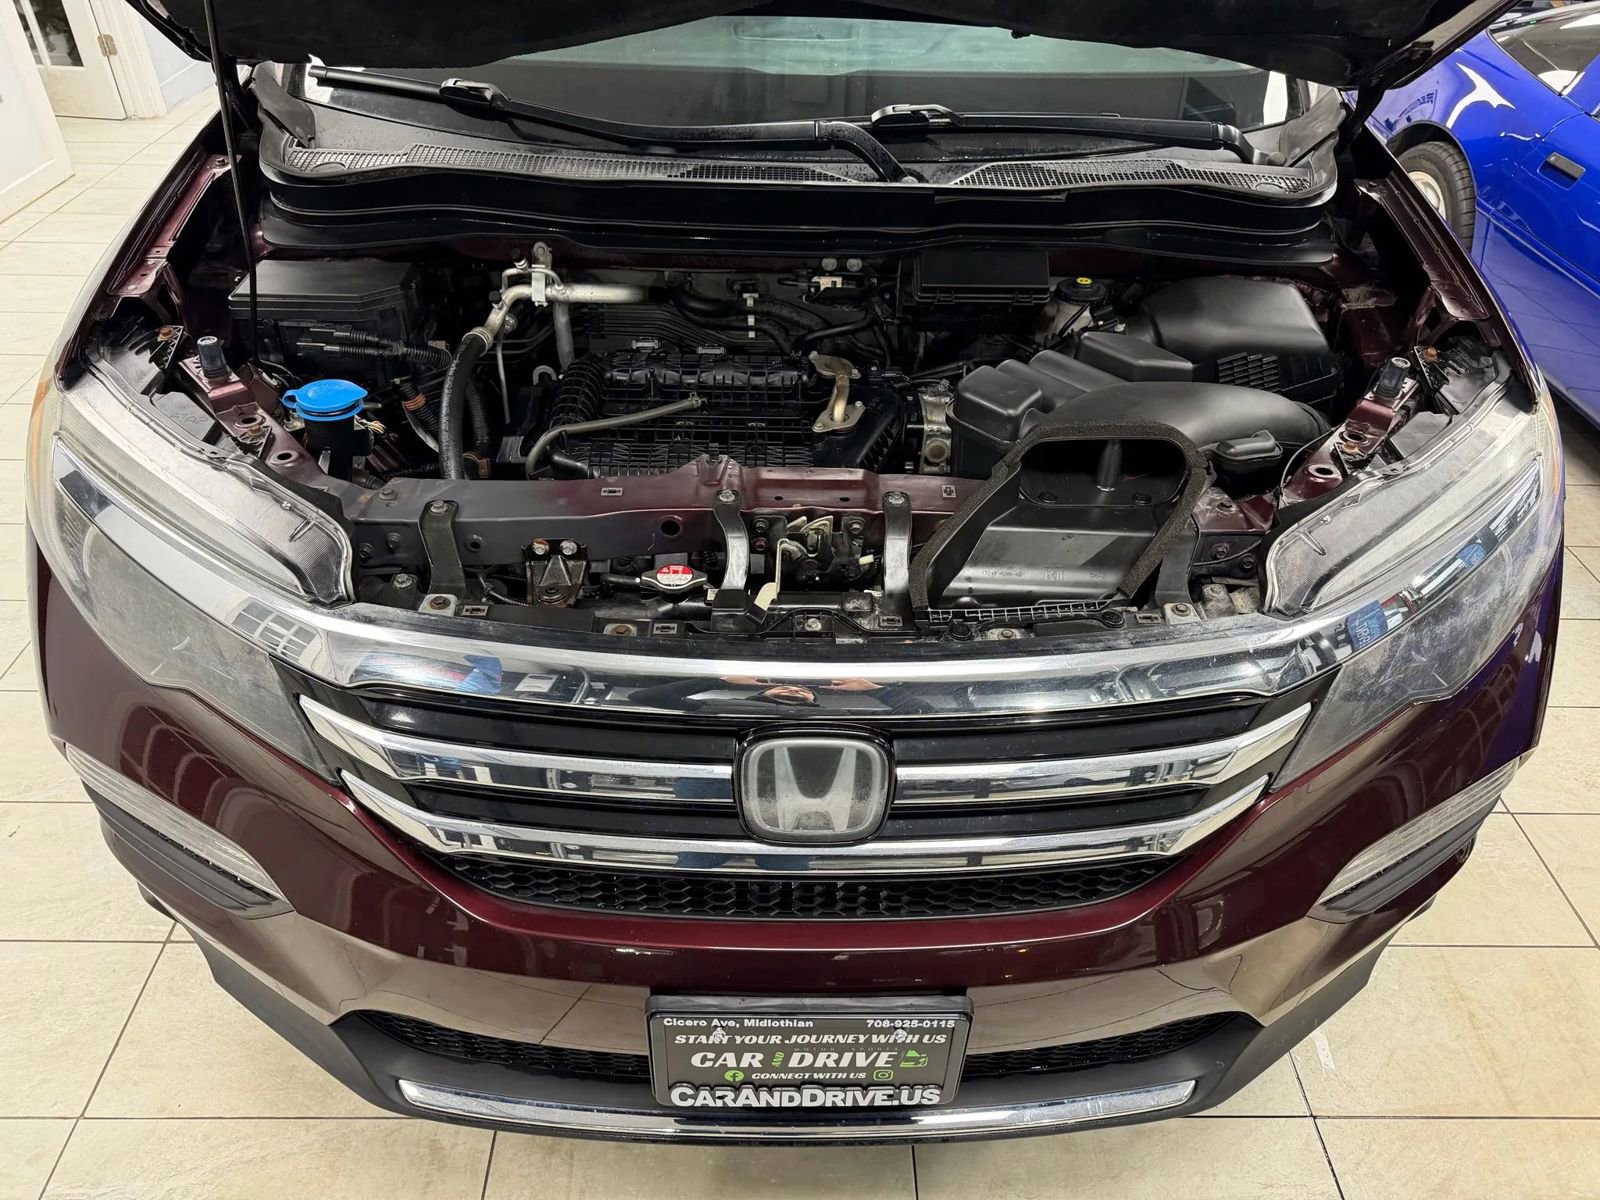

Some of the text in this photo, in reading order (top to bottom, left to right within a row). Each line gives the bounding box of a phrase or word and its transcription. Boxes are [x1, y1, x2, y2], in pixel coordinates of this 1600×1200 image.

[663, 1018, 814, 1029] Cicero Ave, Midlothian
[866, 1020, 955, 1028] 708-925-0115
[735, 1034, 783, 1045] YOUR
[784, 1034, 870, 1044] JOURNEY
[922, 1034, 947, 1044] US
[690, 1051, 898, 1068] CAR AND DRIVE
[751, 1072, 811, 1080] CONNECT
